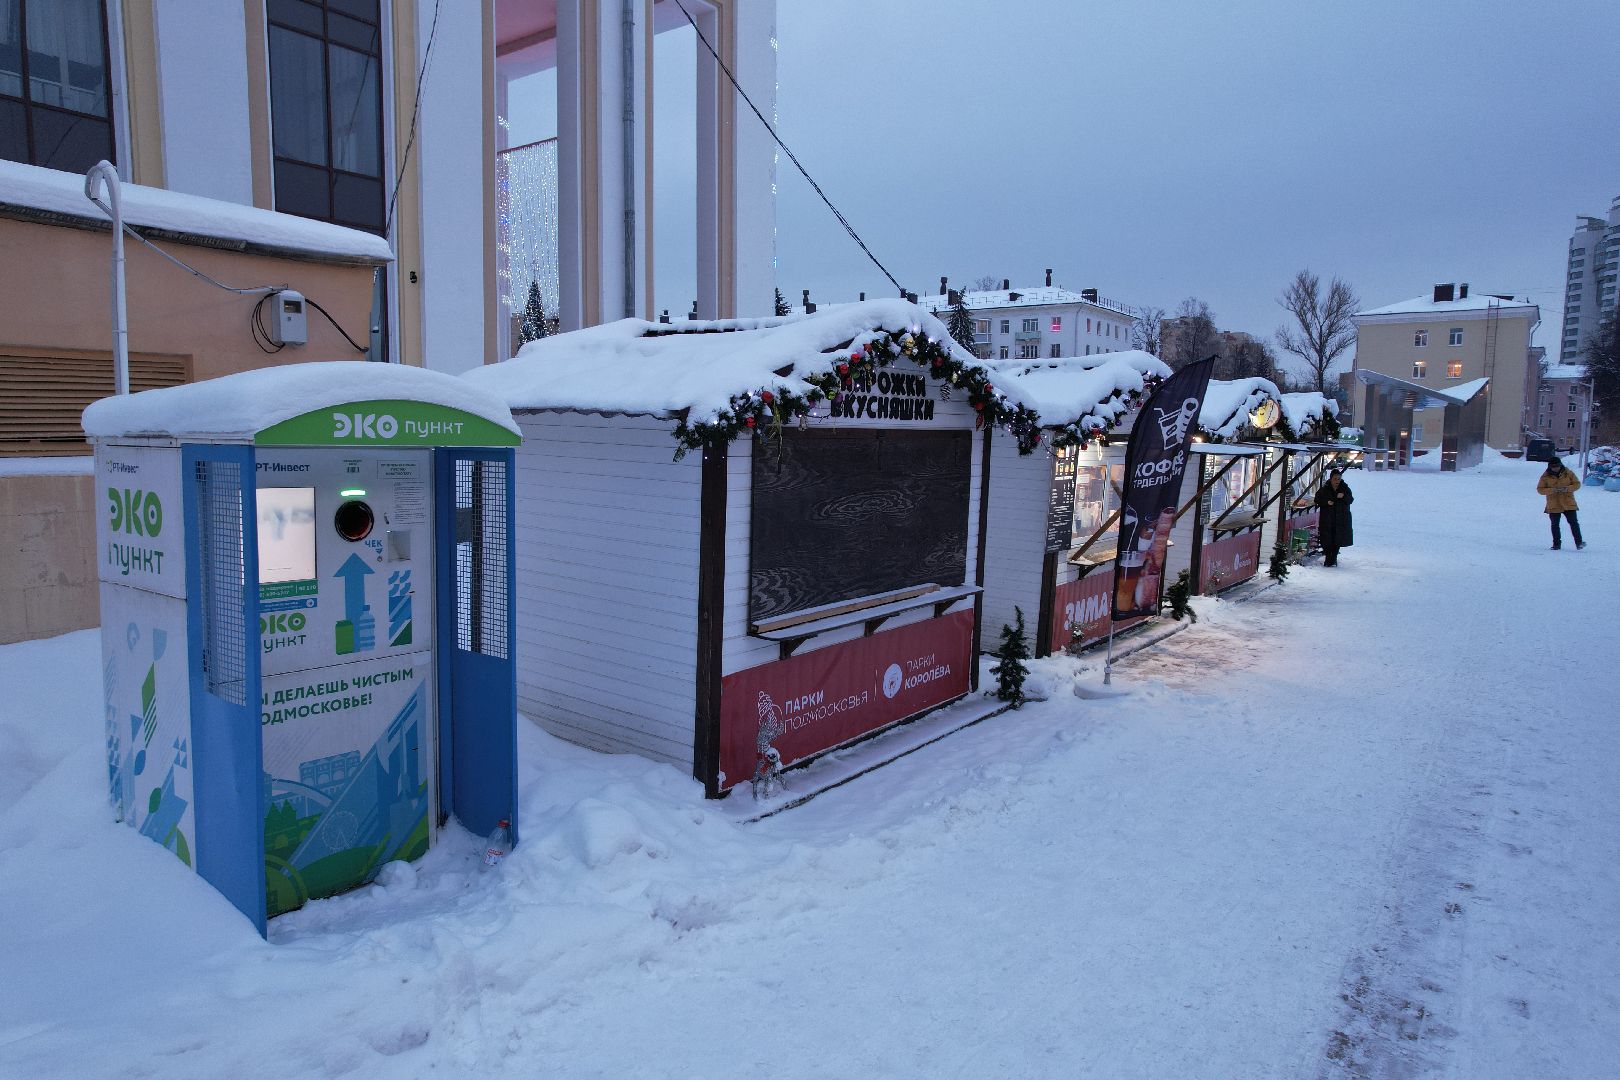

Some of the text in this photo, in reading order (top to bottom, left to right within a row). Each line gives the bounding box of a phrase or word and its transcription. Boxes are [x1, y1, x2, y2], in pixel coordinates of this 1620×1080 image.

[831, 394, 934, 420] ВКУСНЯШКИ
[333, 412, 399, 439] ЭКО
[255, 462, 310, 473] РТ-Инвест
[108, 487, 163, 538] ЭКО
[365, 540, 383, 548] ЧЕК
[263, 634, 307, 654] ункт
[906, 653, 935, 673] ПАРКИ
[260, 668, 414, 706] Ы ДЕЛАЕШЬ ЧИСТЫМ
[905, 664, 951, 690] КОРОЛЁВА
[261, 692, 373, 726] ОДМОСКОВЬЕ!
[784, 690, 869, 734] ПОДМОСКОВЬЯ
[785, 690, 824, 715] ПАРКИ
